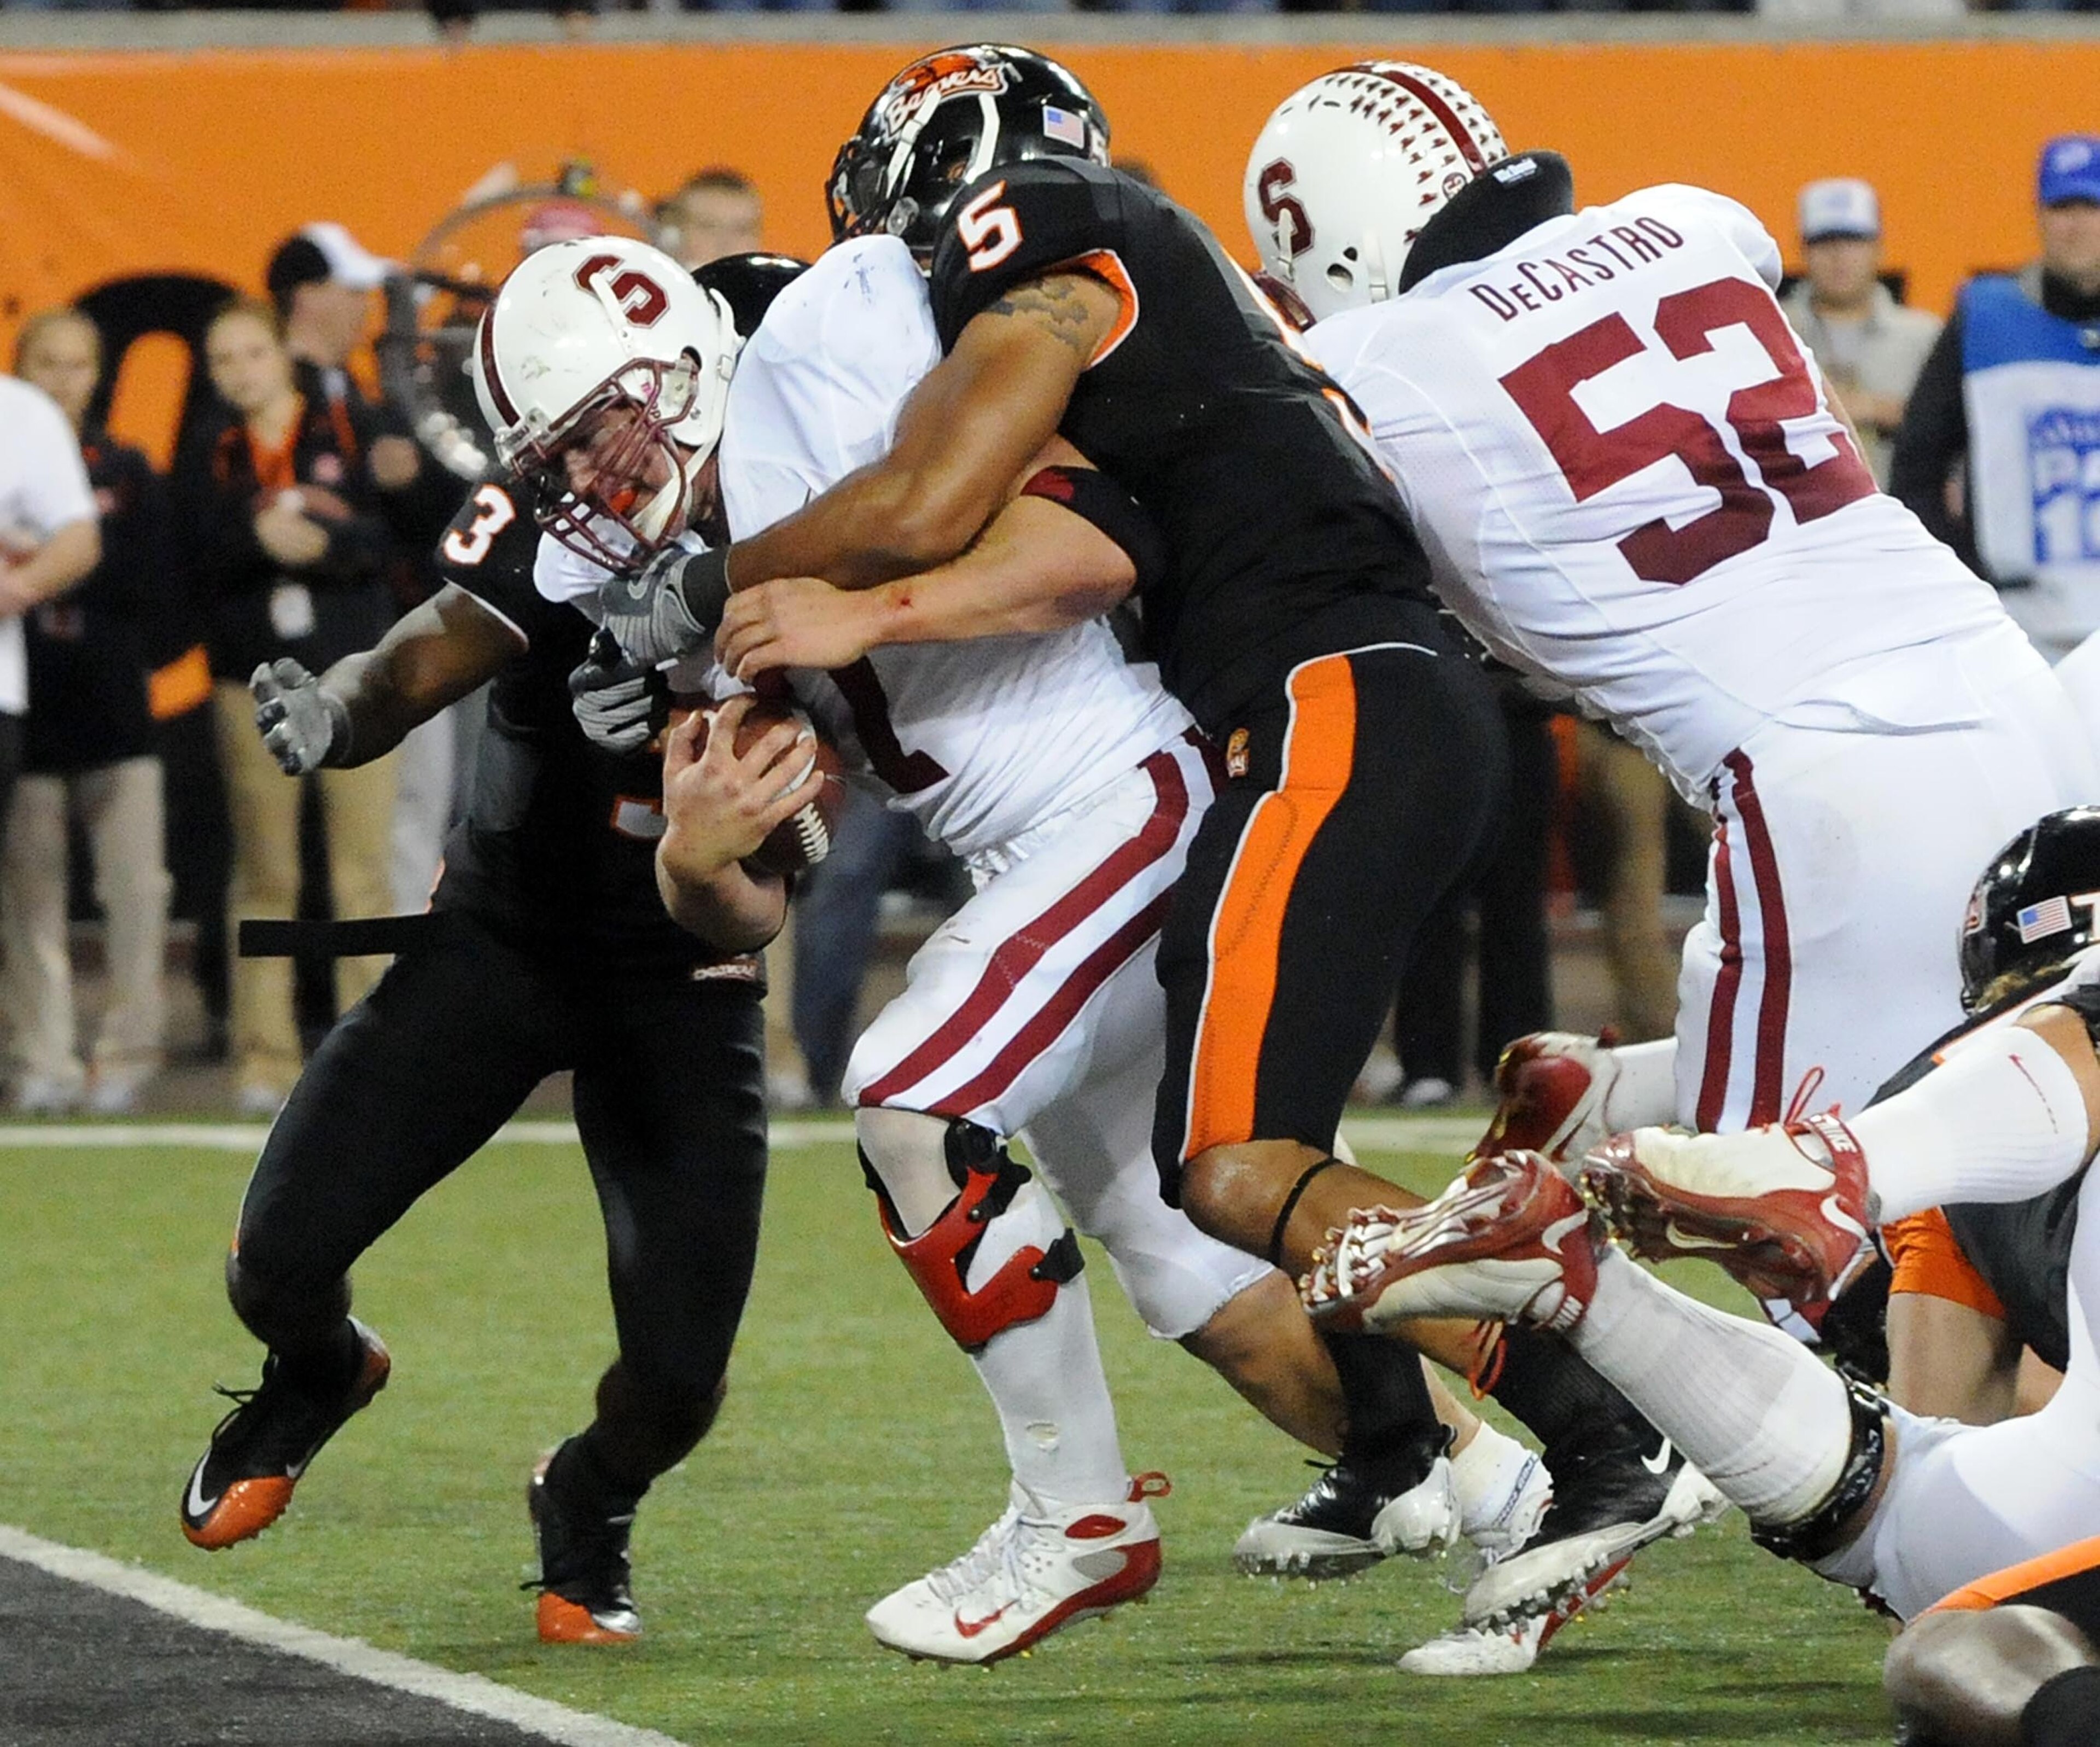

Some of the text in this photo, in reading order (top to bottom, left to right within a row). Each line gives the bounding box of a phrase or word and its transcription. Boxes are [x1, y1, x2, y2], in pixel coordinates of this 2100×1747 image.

[957, 179, 1024, 272] 5
[1258, 157, 1315, 259] S
[572, 254, 670, 329] S
[1498, 277, 1878, 585] 52
[444, 484, 517, 566] 3
